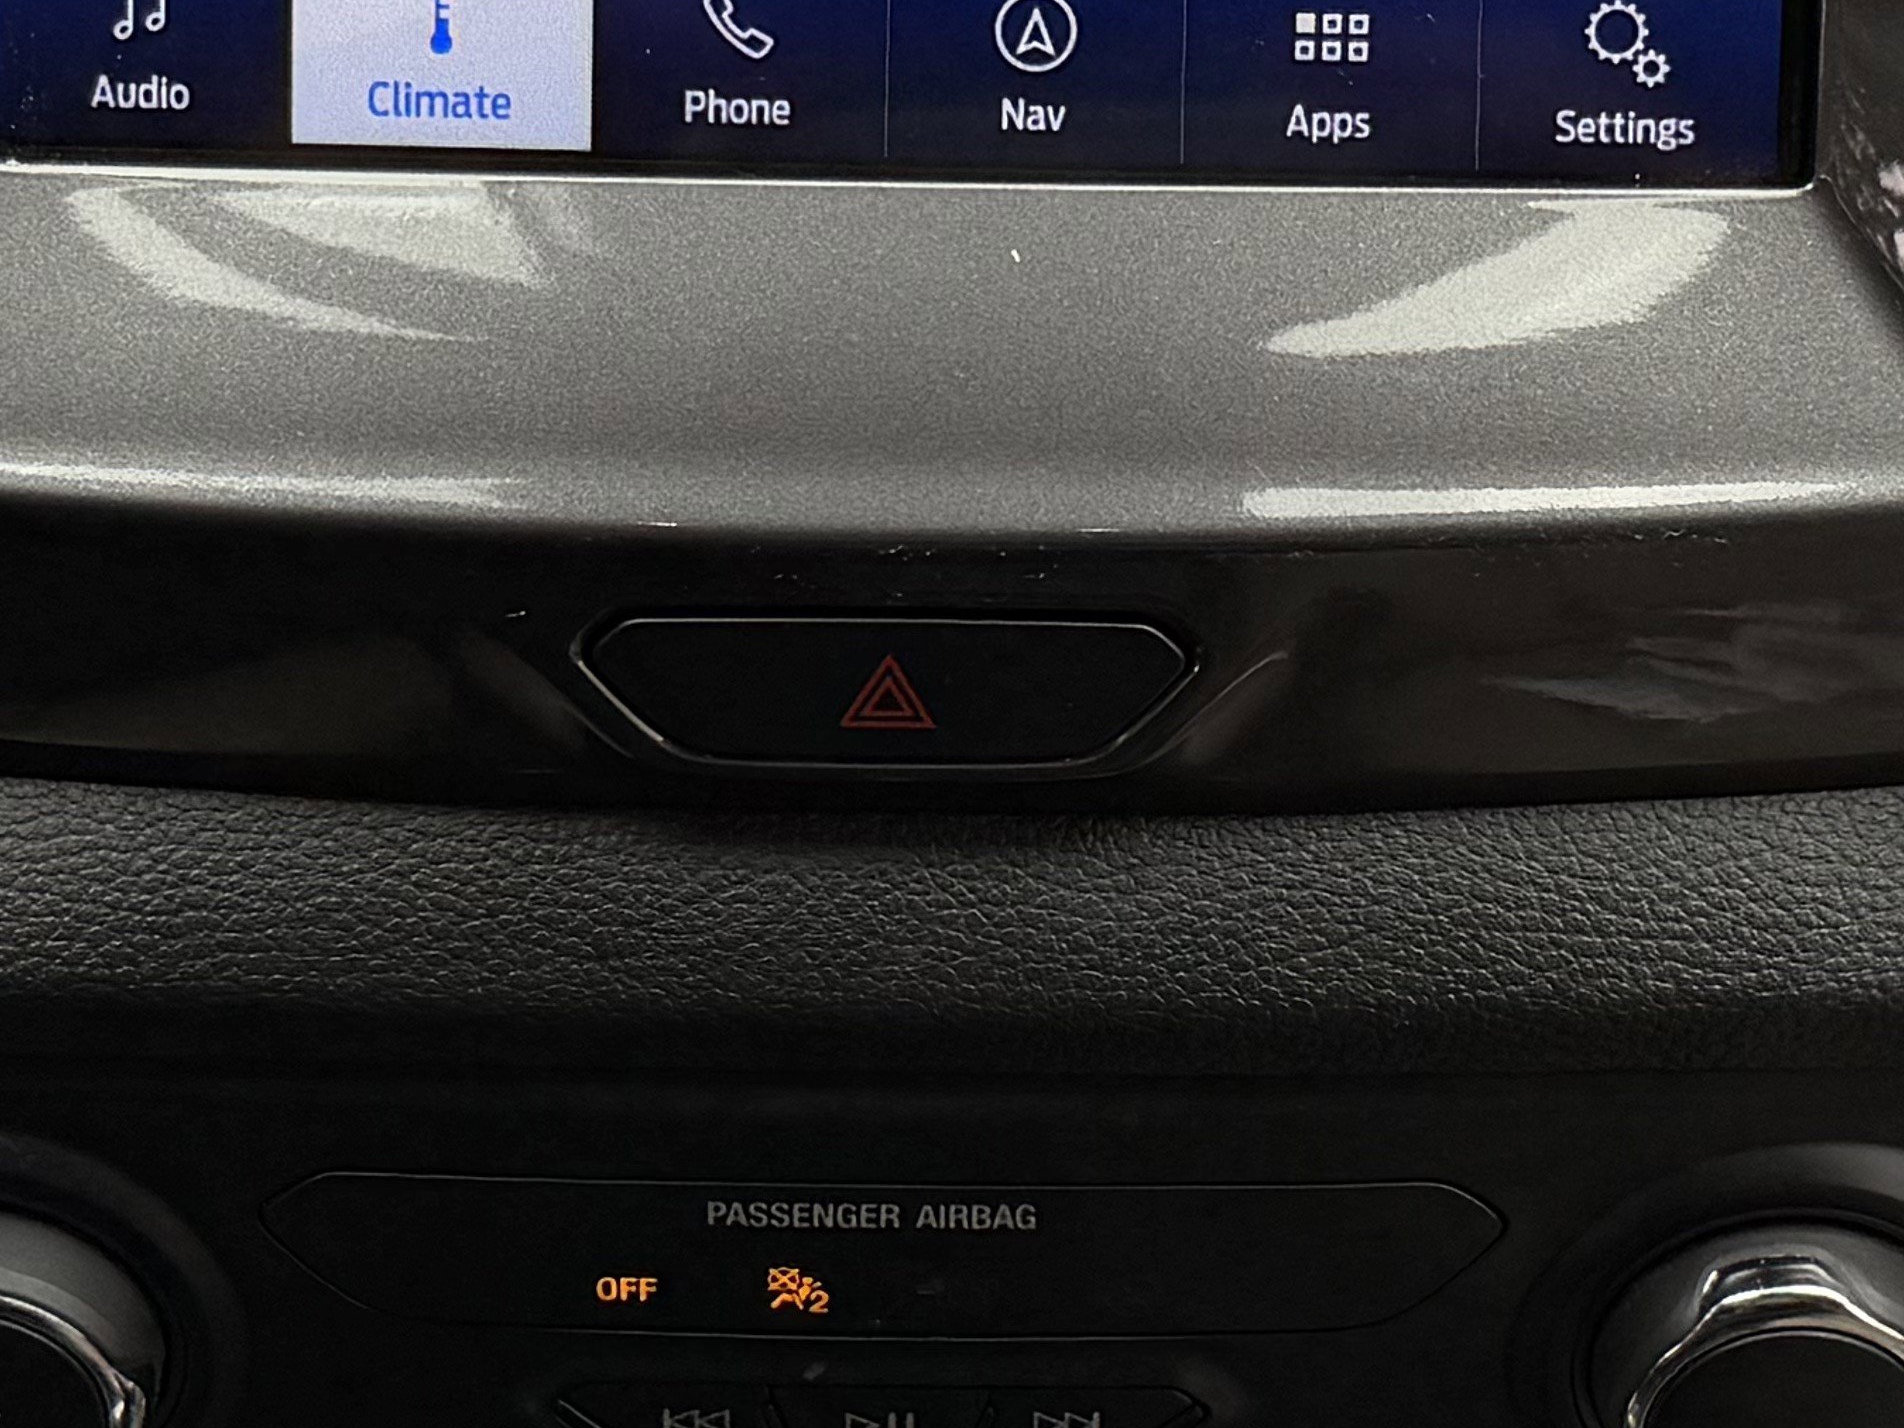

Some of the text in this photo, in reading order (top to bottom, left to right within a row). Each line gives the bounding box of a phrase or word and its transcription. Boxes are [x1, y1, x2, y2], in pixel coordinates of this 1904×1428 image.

[91, 74, 191, 111] Audio
[367, 80, 512, 120] Climate
[684, 88, 791, 126] Phone
[1000, 97, 1066, 132] Nav
[1286, 103, 1371, 144] Apps
[1554, 109, 1696, 151] Settings
[707, 1200, 1037, 1231] PASSENGER AIRBAG
[595, 1275, 659, 1303] OFF
